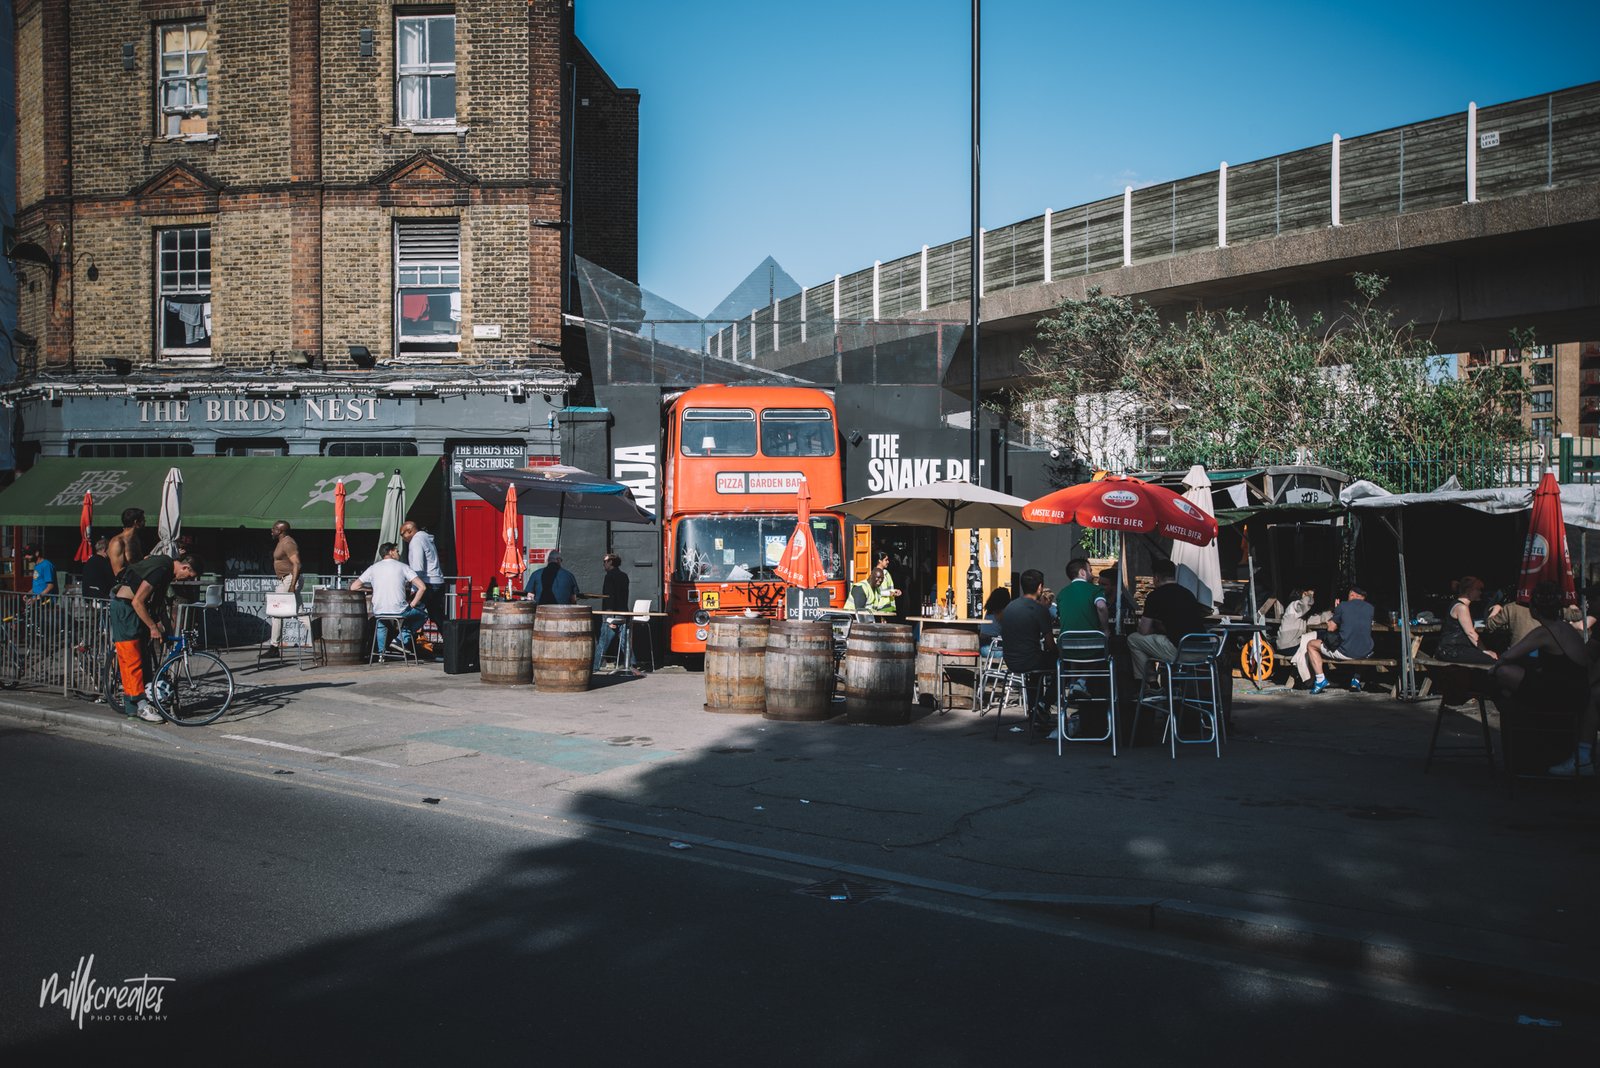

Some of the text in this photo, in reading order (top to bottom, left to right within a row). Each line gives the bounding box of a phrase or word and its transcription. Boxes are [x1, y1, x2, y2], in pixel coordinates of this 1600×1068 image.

[137, 398, 380, 422] THE BIRDS NEST
[455, 445, 471, 455] THE
[503, 444, 524, 455] NEST
[868, 434, 899, 458] THE
[465, 458, 515, 469] GUESTHOUSE
[76, 470, 128, 483] THE
[614, 444, 656, 516] AJA
[868, 458, 942, 492] SNAKE
[60, 481, 134, 495] BIRDS
[718, 478, 744, 489] PIZZA
[750, 478, 784, 489] GARDEN
[1031, 508, 1065, 519] AMSTEL BIER
[1091, 515, 1143, 528] AMSTEL BIER
[1164, 524, 1202, 541] AMSTEL BIER
